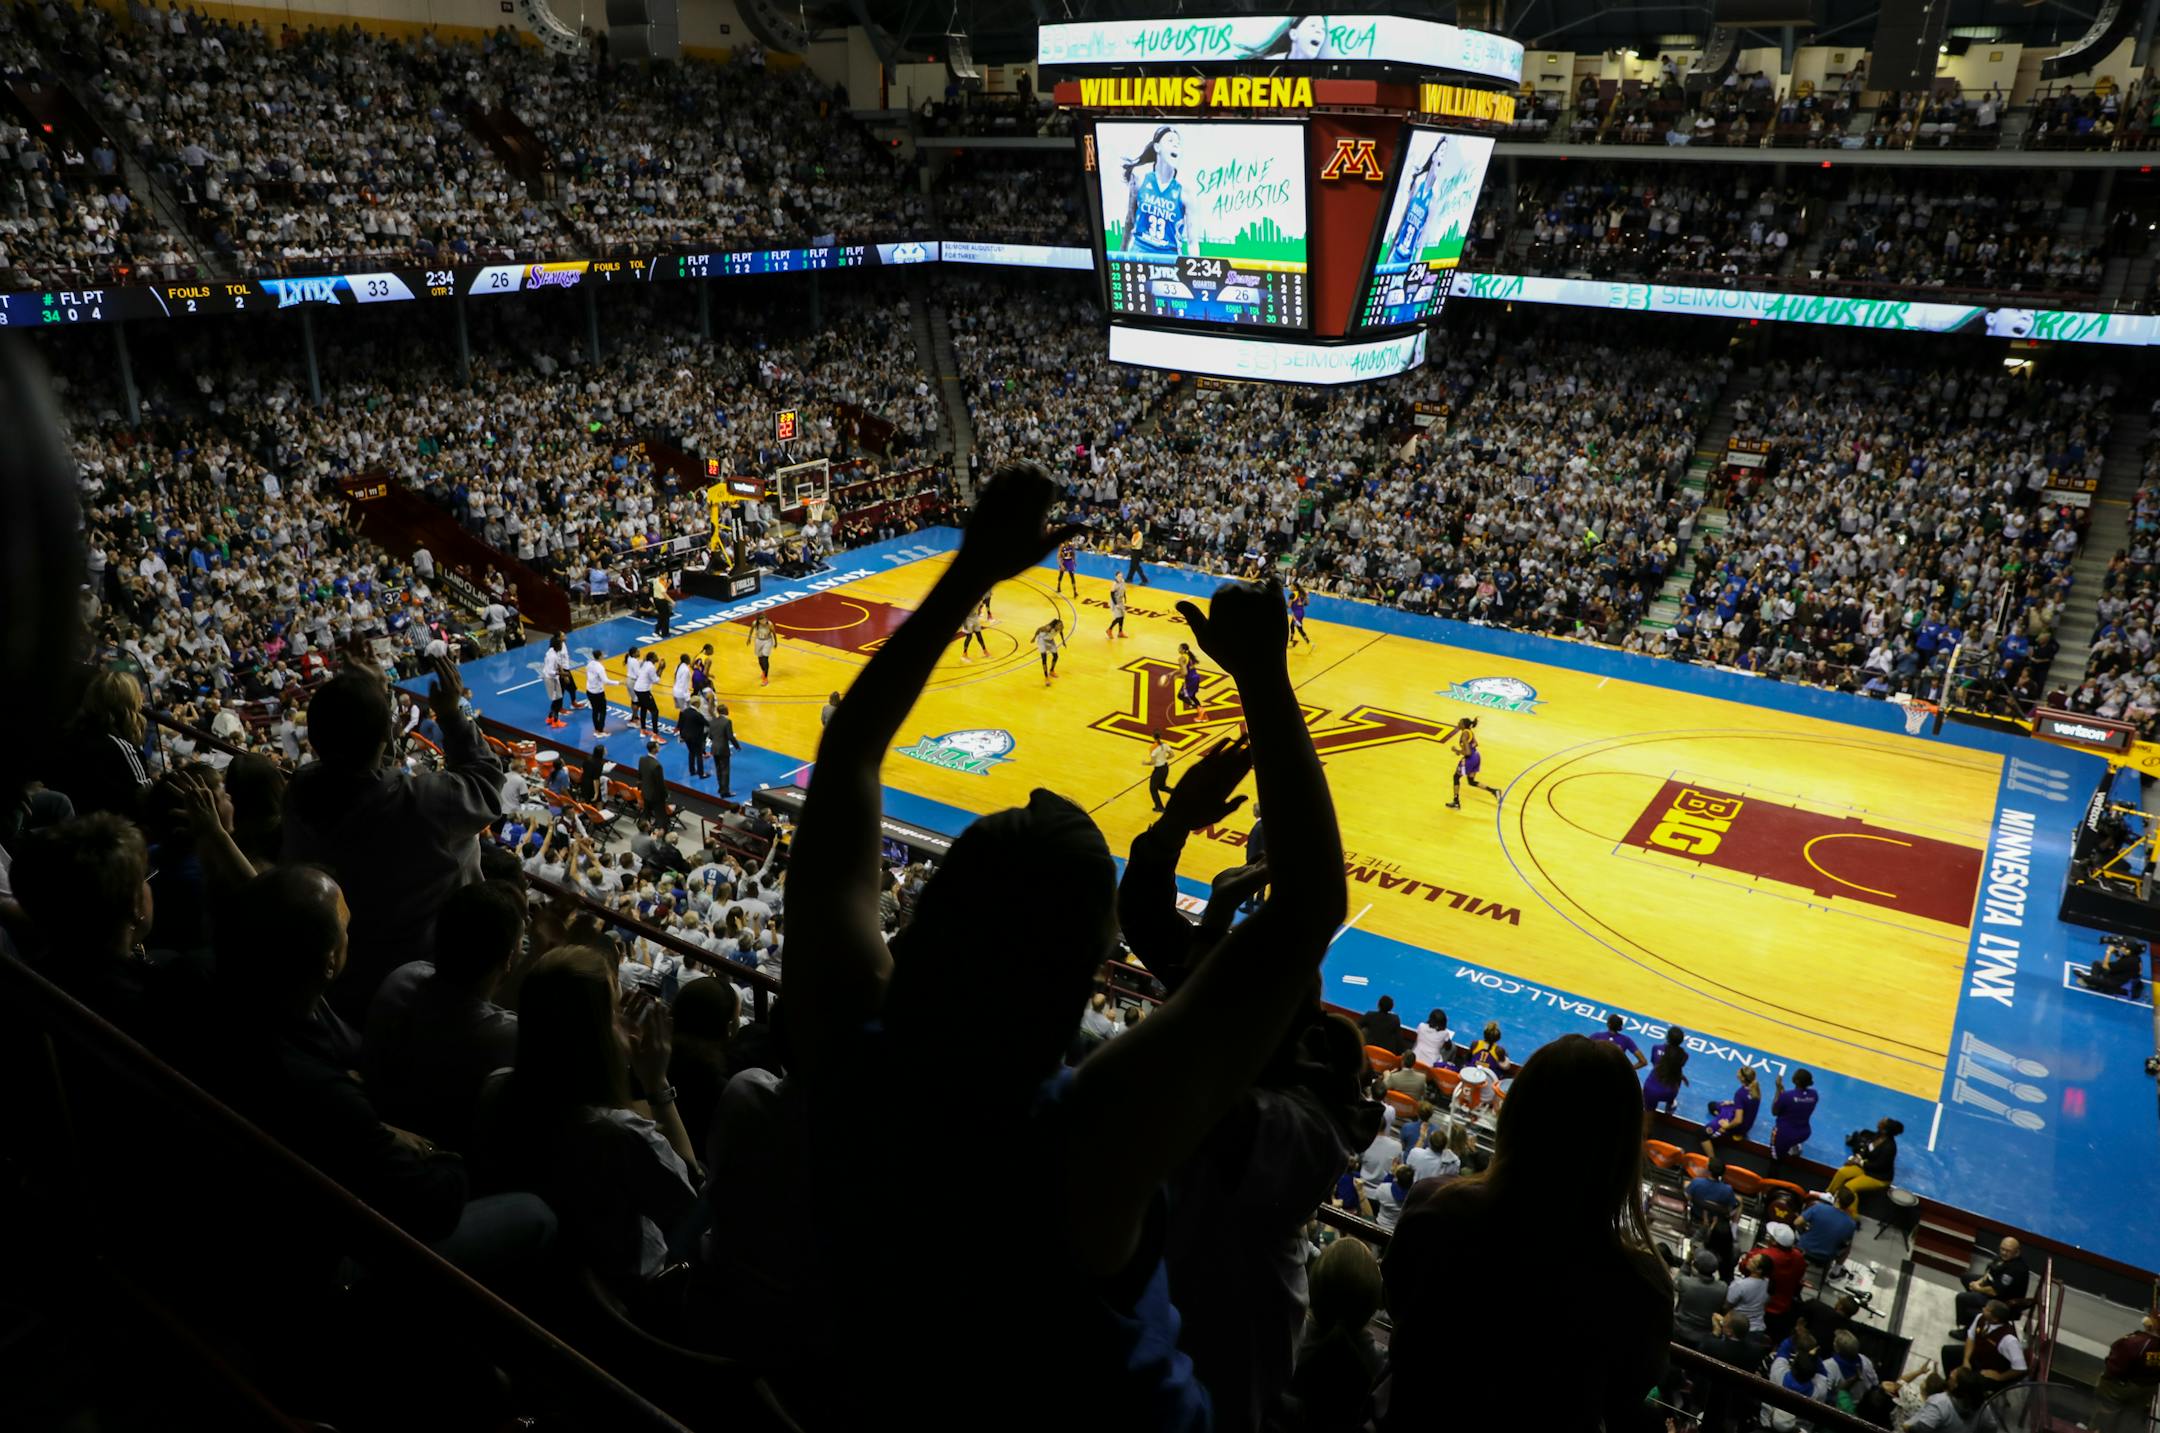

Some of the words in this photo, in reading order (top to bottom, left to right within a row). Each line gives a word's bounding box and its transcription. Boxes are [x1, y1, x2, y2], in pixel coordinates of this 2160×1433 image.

[1133, 24, 1233, 57] AUGUSTUS
[1080, 77, 1202, 107] WILLIAMS
[1210, 77, 1313, 107] ARENA
[1422, 83, 1493, 119] WILLIAMS
[1321, 138, 1384, 180] M
[1195, 157, 1276, 196] SEIMONE
[1144, 192, 1175, 211] MAYO
[1211, 179, 1290, 222] AUGUSTUS
[1140, 202, 1176, 222] CLINIC
[1148, 215, 1165, 240] 33
[594, 262, 620, 272] FOULS
[629, 260, 646, 269] TOL
[605, 271, 610, 281] 1
[635, 269, 640, 279] 1
[1148, 265, 1180, 282] LYNX
[1186, 259, 1222, 277] 2:34
[426, 270, 454, 287] 2:34
[490, 272, 509, 288] 26
[60, 291, 81, 305] FL
[83, 290, 104, 304] PT
[168, 287, 210, 299] FOULS
[225, 284, 251, 295] TOL
[275, 278, 341, 309] LYNX
[368, 280, 389, 297] 33
[1163, 284, 1177, 295] 33
[1201, 290, 1209, 301] 2
[1235, 289, 1249, 300] 26
[187, 300, 196, 312] 2
[235, 297, 244, 309] 2
[1764, 294, 1909, 329] AUGUSTUS
[42, 310, 61, 322] 34
[68, 309, 78, 321] 0
[92, 307, 102, 320] 4
[779, 422, 793, 438] 22
[807, 568, 877, 590] LYNX
[2054, 722, 2106, 741] verizon
[1982, 808, 2036, 927] MINNESOTA
[1344, 862, 1520, 926] WILLIAM
[1970, 933, 2020, 1008] LYNX
